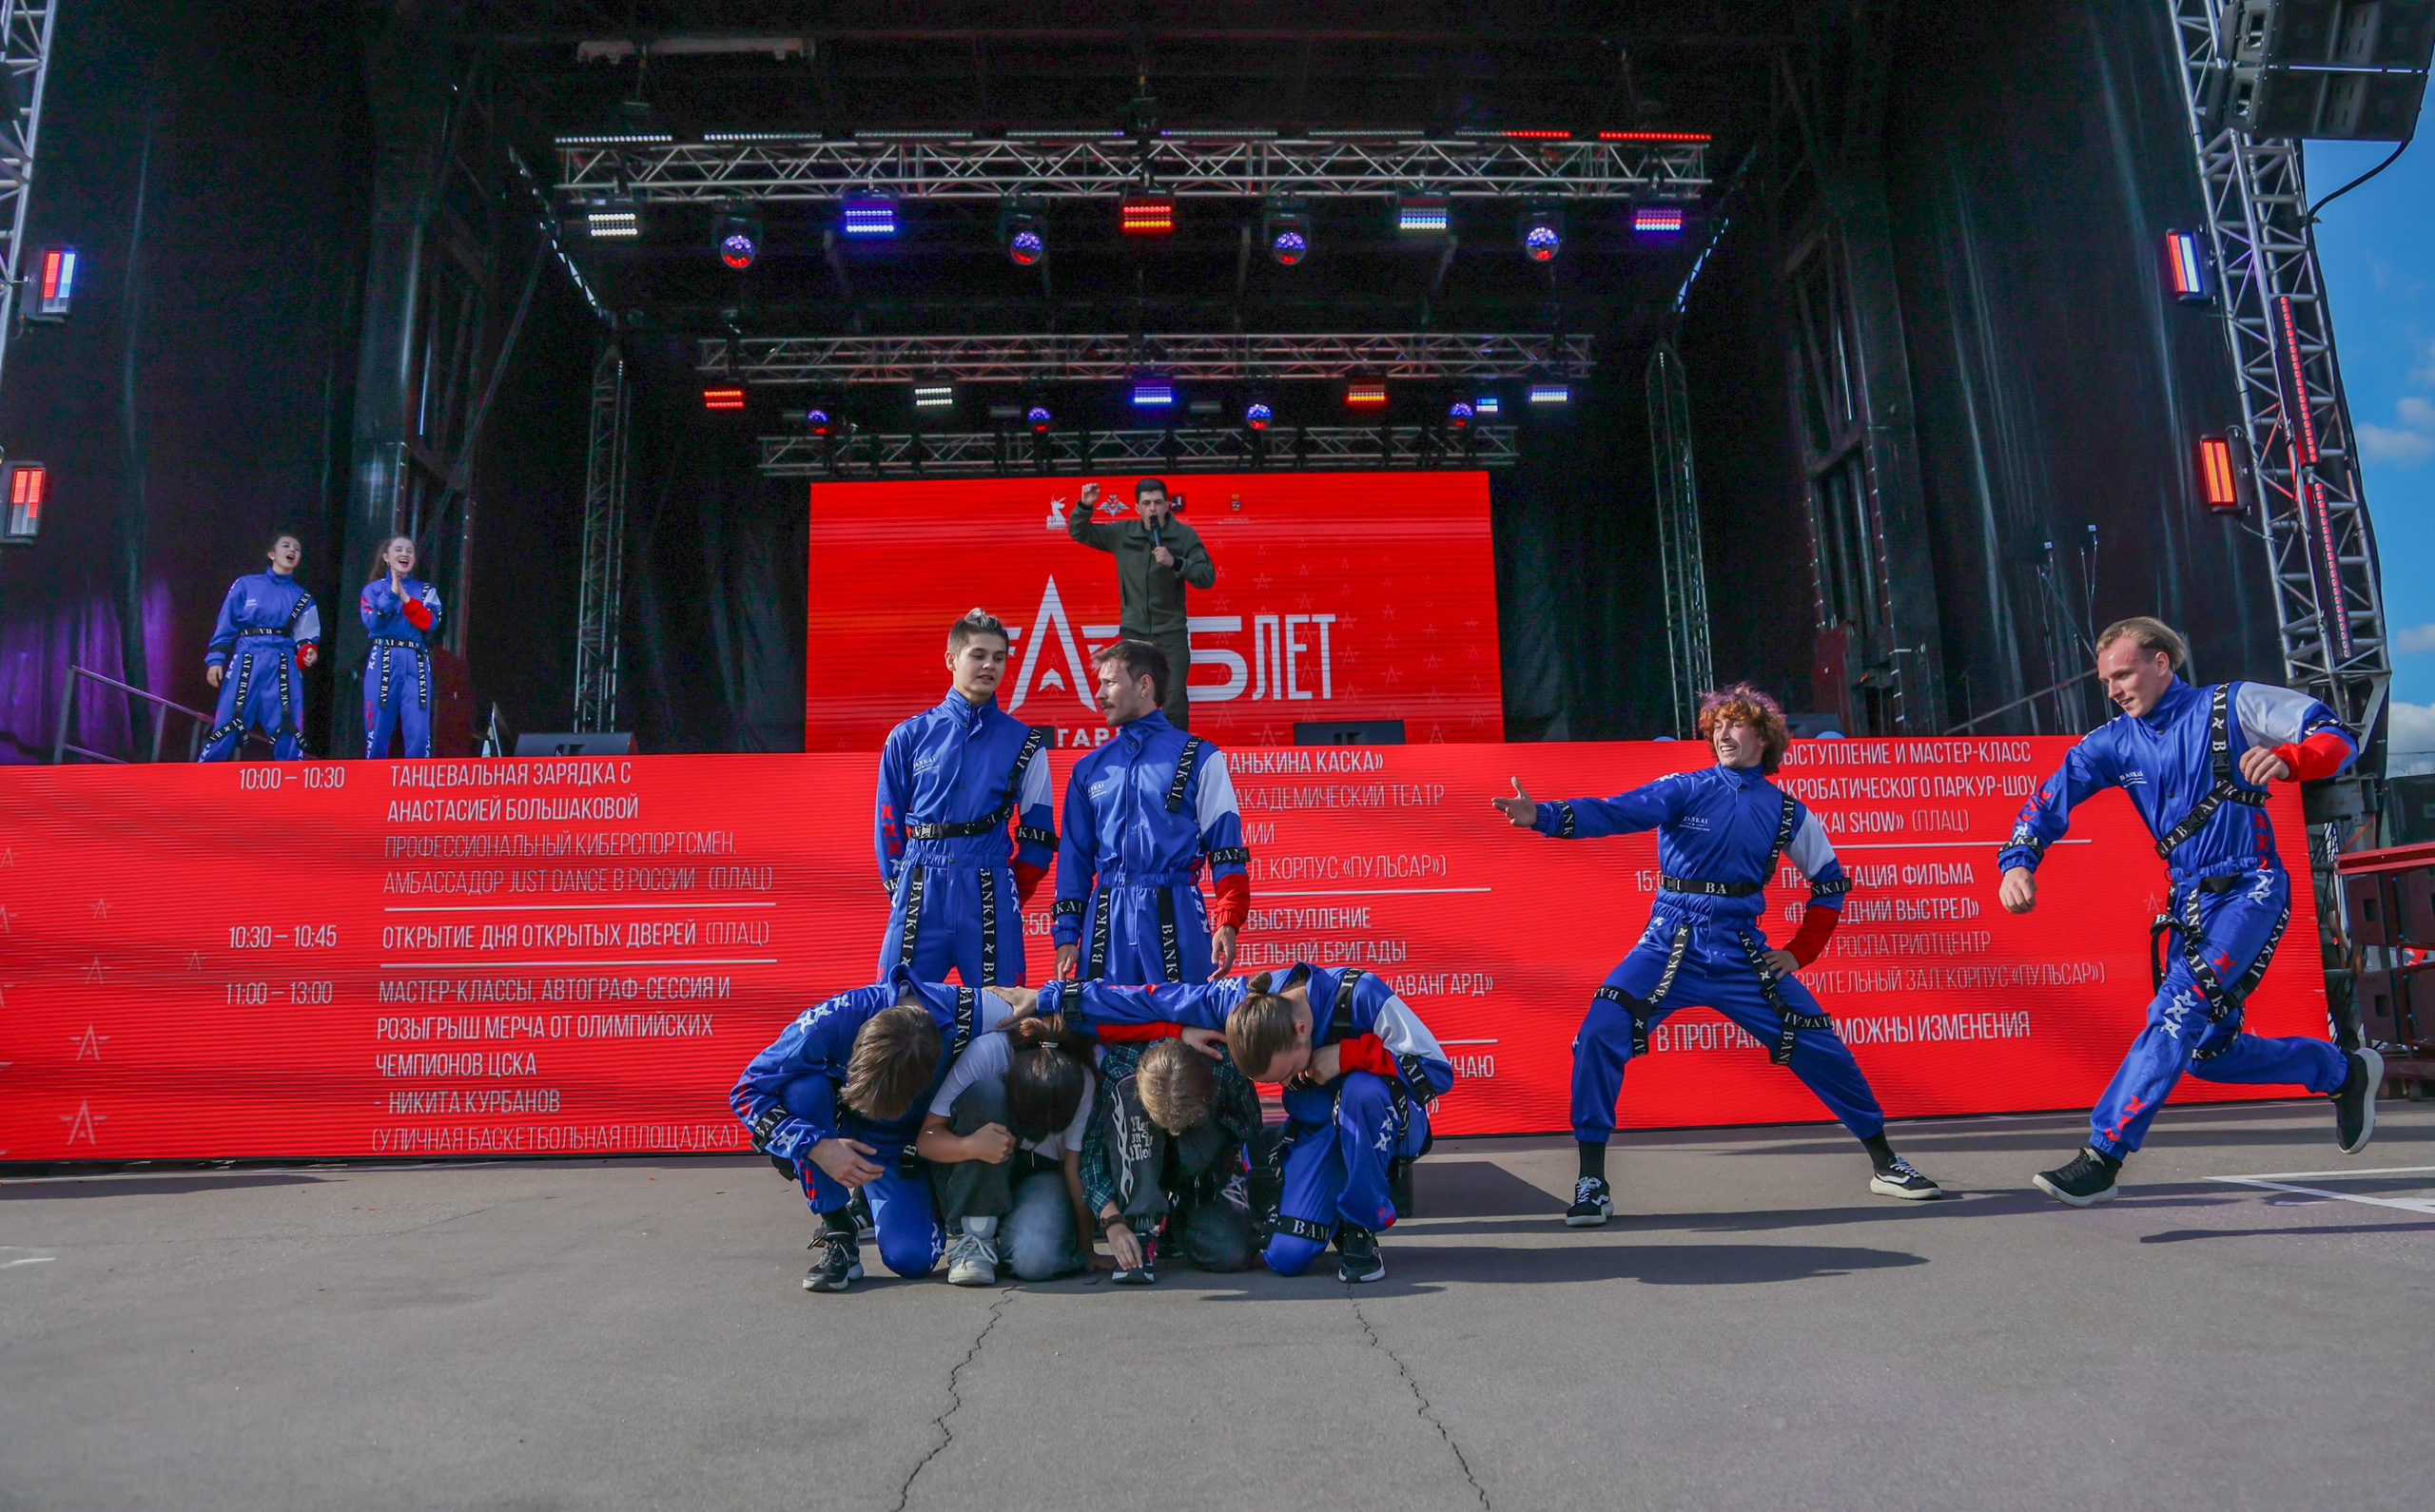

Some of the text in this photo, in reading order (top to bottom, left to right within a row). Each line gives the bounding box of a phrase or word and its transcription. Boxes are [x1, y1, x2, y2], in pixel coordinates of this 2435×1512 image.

[1222, 750, 1385, 774] АНЬКИНА КАСКА»
[1780, 741, 2032, 766] ЫСТУПЛЕНИЕ И МАСТЕР-КЛАСС
[240, 767, 282, 790] 10:00
[302, 766, 345, 788] 10:30
[390, 762, 632, 789] ТАНЦЕВАЛЬНАЯ ЗАРЯДКА С
[1171, 740, 1199, 799] BANKAI
[1390, 784, 1445, 807] ТЕАТР
[1777, 774, 2037, 800] АКРОБАТИЧЕСКОГО ПАРКУР-ШОУ
[386, 792, 638, 823] АНАСТАСИЕЙ БОЛЬШАКОВОЙ
[1849, 811, 1905, 833] SHOW»
[1912, 809, 1970, 832] (ПЛАЦ)
[384, 830, 571, 859] ПРОФЕССИОНАЛЬНЫЙ
[1240, 823, 1276, 844] МИИ
[382, 866, 773, 896] АМБАССАДОР JUST DANCE В РОССИИ (ПЛАЦ)
[1270, 856, 1338, 881] КОРПУС
[1343, 854, 1447, 879] «ПУЛЬСАР»)
[1901, 862, 1975, 886] ФИЛЬМА
[903, 881, 924, 950] BANKAI
[1247, 906, 1372, 931] ВЫСТУПЛЕНИЕ
[1896, 897, 1980, 922] ВЫСТРЕЛ»
[228, 925, 272, 948] 10:30
[293, 924, 338, 948] 10:45
[382, 919, 769, 950] ОТКРЫТИЕ ДНЯ ОТКРЫТЫХ ДВЕРЕЙ (ПЛАЦ)
[1091, 894, 1109, 964] BANKAI
[1235, 938, 1407, 967] ДЕЛЬНОЙ БРИГАДЫ
[1837, 931, 1992, 959] РОСПАТРИОТЦЕНТР
[1656, 942, 1685, 997] BANKAI
[1949, 966, 2008, 990] КОРПУС
[2012, 961, 2106, 987] «ПУЛЬСАР»)
[225, 981, 267, 1005] 11:00
[289, 981, 333, 1004] 13:00
[379, 976, 730, 1004] МАСТЕР-КЛАССЫ, АВТОГРАФ-СЕССИЯ И
[1386, 973, 1494, 997] «АВАНГАРД»
[377, 1010, 714, 1040] РОЗЫГРЫШ МЕРЧА ОТ ОЛИМПИЙСКИХ
[953, 986, 973, 1055] BANKAI
[1656, 1024, 1670, 1052] В
[1674, 1021, 1765, 1052] ПРОГРАМ
[1918, 1011, 2030, 1042] ИЗМЕНЕНИЯ
[375, 1052, 537, 1078] ЧЕМПИОНОВ ЦСКА
[388, 1090, 460, 1115] НИКИТА
[465, 1089, 561, 1114] КУРБАНОВ
[372, 1125, 739, 1152] (УЛИЧНАЯ БАСКЕТБОЛЬНАЯ ПЛОЩАДКА)
